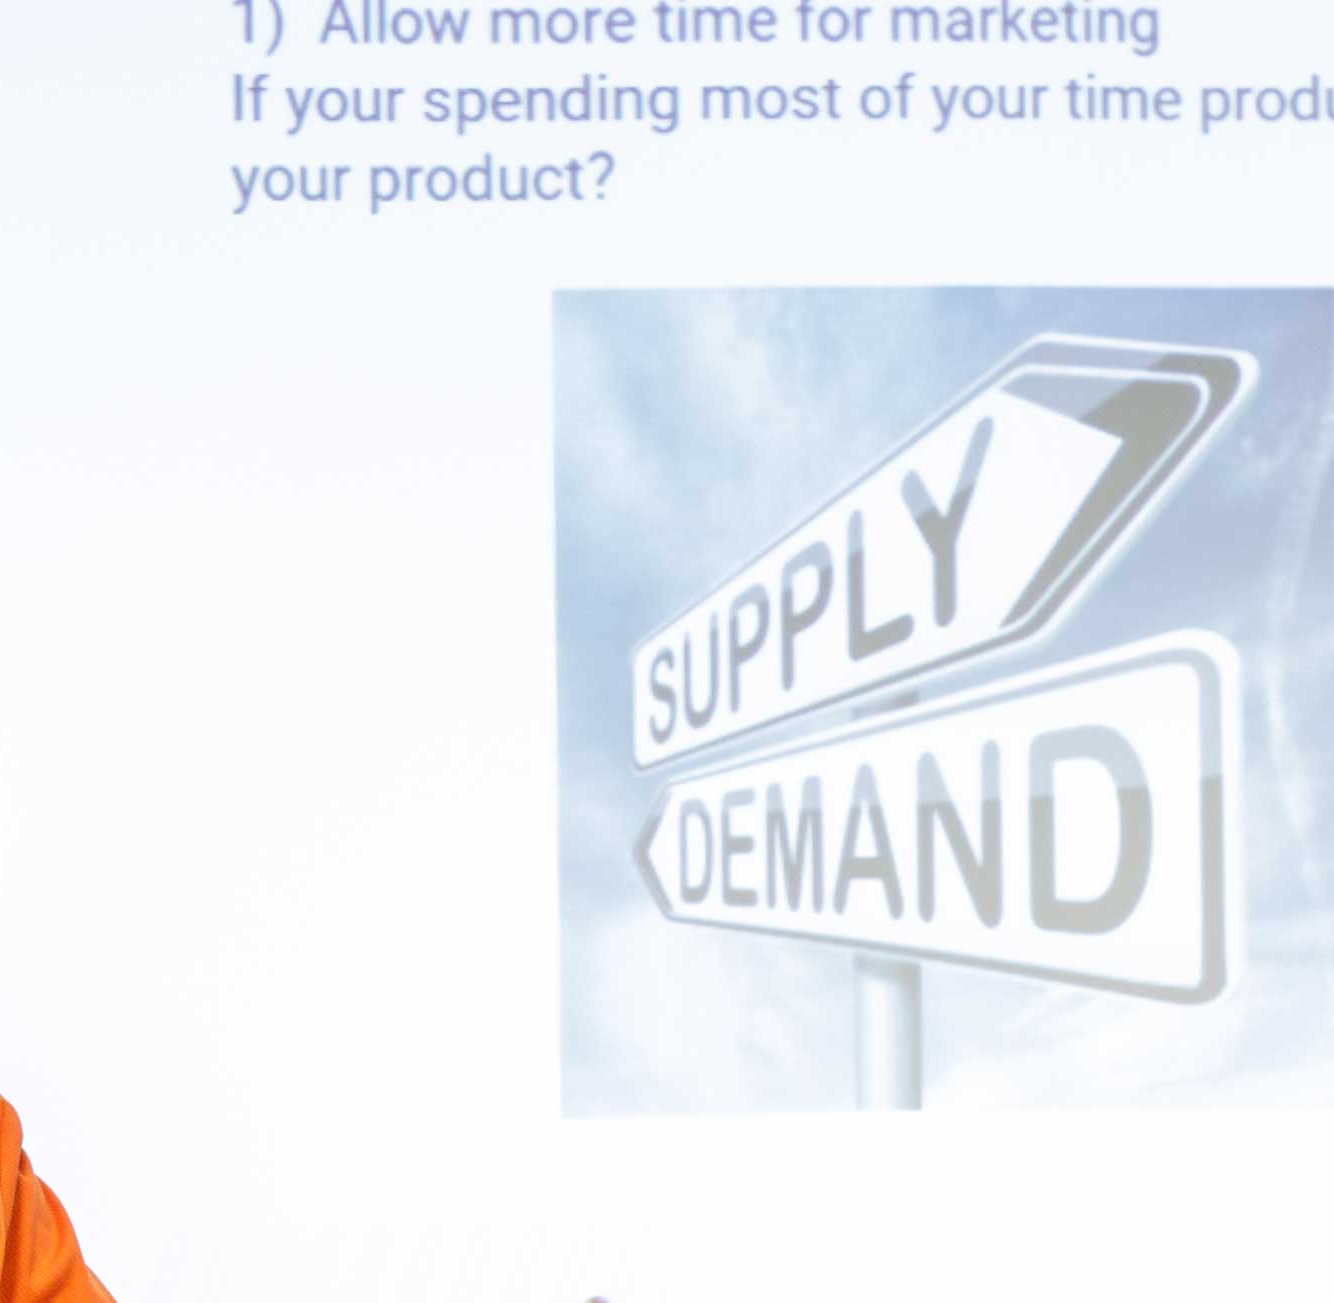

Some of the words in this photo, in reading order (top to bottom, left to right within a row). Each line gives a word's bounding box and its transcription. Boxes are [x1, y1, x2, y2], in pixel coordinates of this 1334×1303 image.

[232, 0, 284, 55] 1)
[319, 0, 470, 44] Allow
[489, 6, 637, 45] more
[652, 0, 779, 44] time
[794, 0, 874, 44] for
[889, 0, 1160, 55] marketing
[232, 72, 269, 122] If
[285, 86, 406, 135] your
[423, 73, 680, 136] spending
[701, 78, 842, 121] most
[860, 71, 916, 120] of
[931, 84, 1048, 133] your
[1064, 72, 1183, 121] time
[231, 165, 352, 214] your
[369, 149, 615, 214] product?
[647, 414, 995, 745] SUPPLY
[678, 723, 1153, 937] DEMAND
